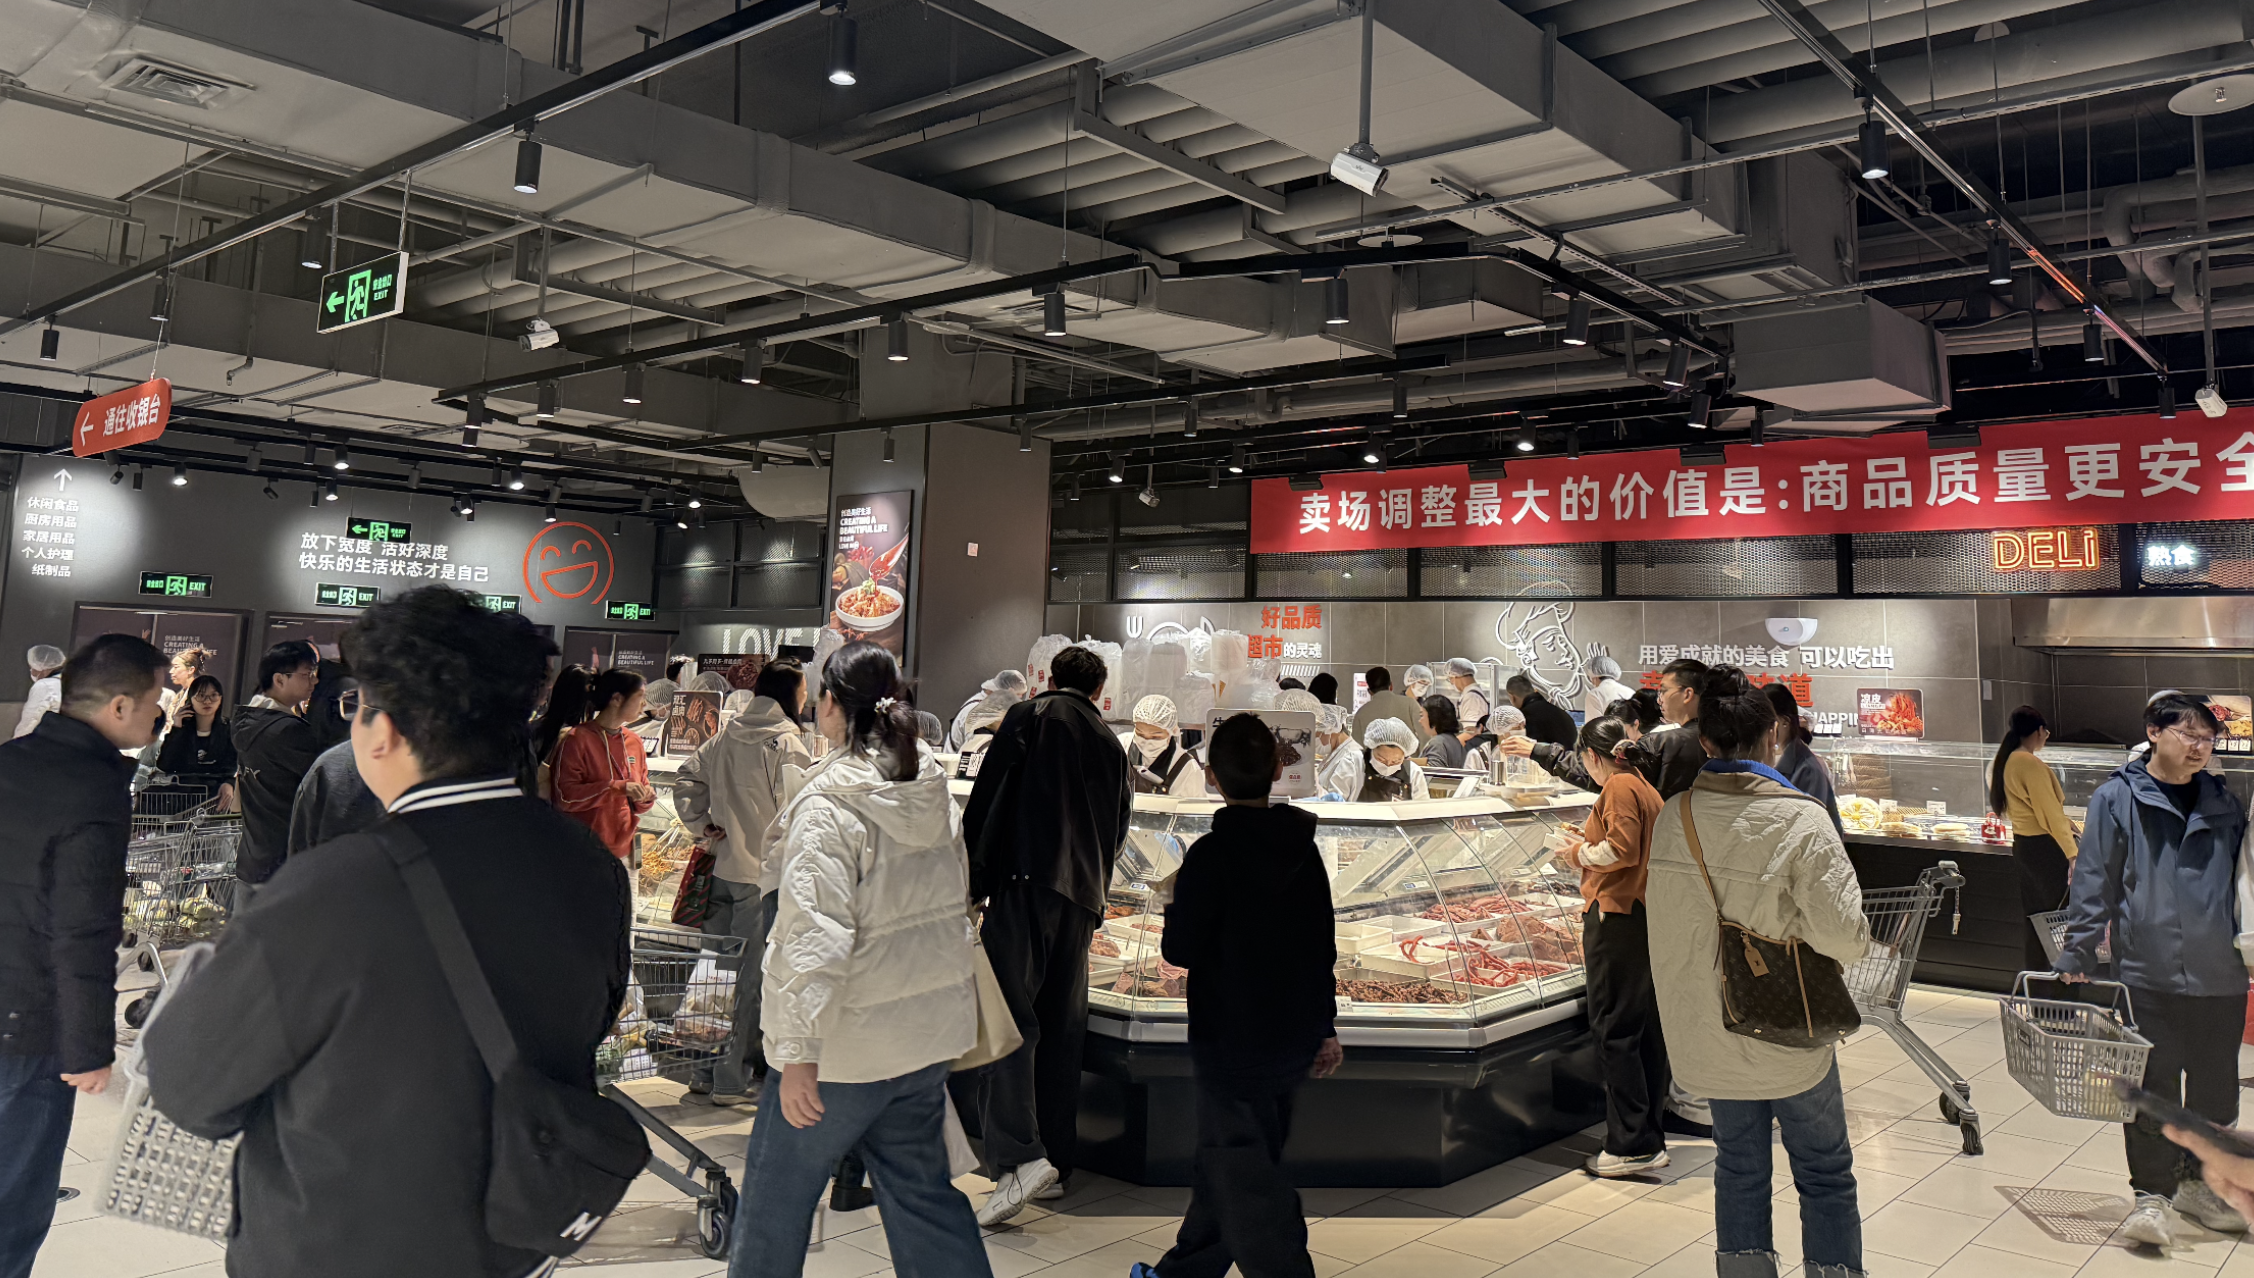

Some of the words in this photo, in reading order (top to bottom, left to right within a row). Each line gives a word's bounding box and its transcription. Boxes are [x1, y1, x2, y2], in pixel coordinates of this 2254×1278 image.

[373, 289, 388, 301] EXIT
[102, 393, 161, 437] 通往收银台
[27, 496, 79, 512] 休闲食品
[24, 513, 77, 528] 厨房用品
[871, 515, 877, 524] A
[873, 523, 888, 533] LIFE
[23, 529, 75, 545] 家居用品
[21, 546, 74, 561] 个人护理
[32, 563, 71, 577] 纸制品
[299, 551, 489, 582] 快乐的生活状态才是自己
[189, 581, 206, 591] EXIT
[358, 592, 374, 602] EXIT
[502, 600, 516, 610] EXIT
[1261, 604, 1322, 629] 好品质
[1638, 644, 1790, 668] 用爱成就的美食
[1799, 646, 1895, 669] 可以吃出
